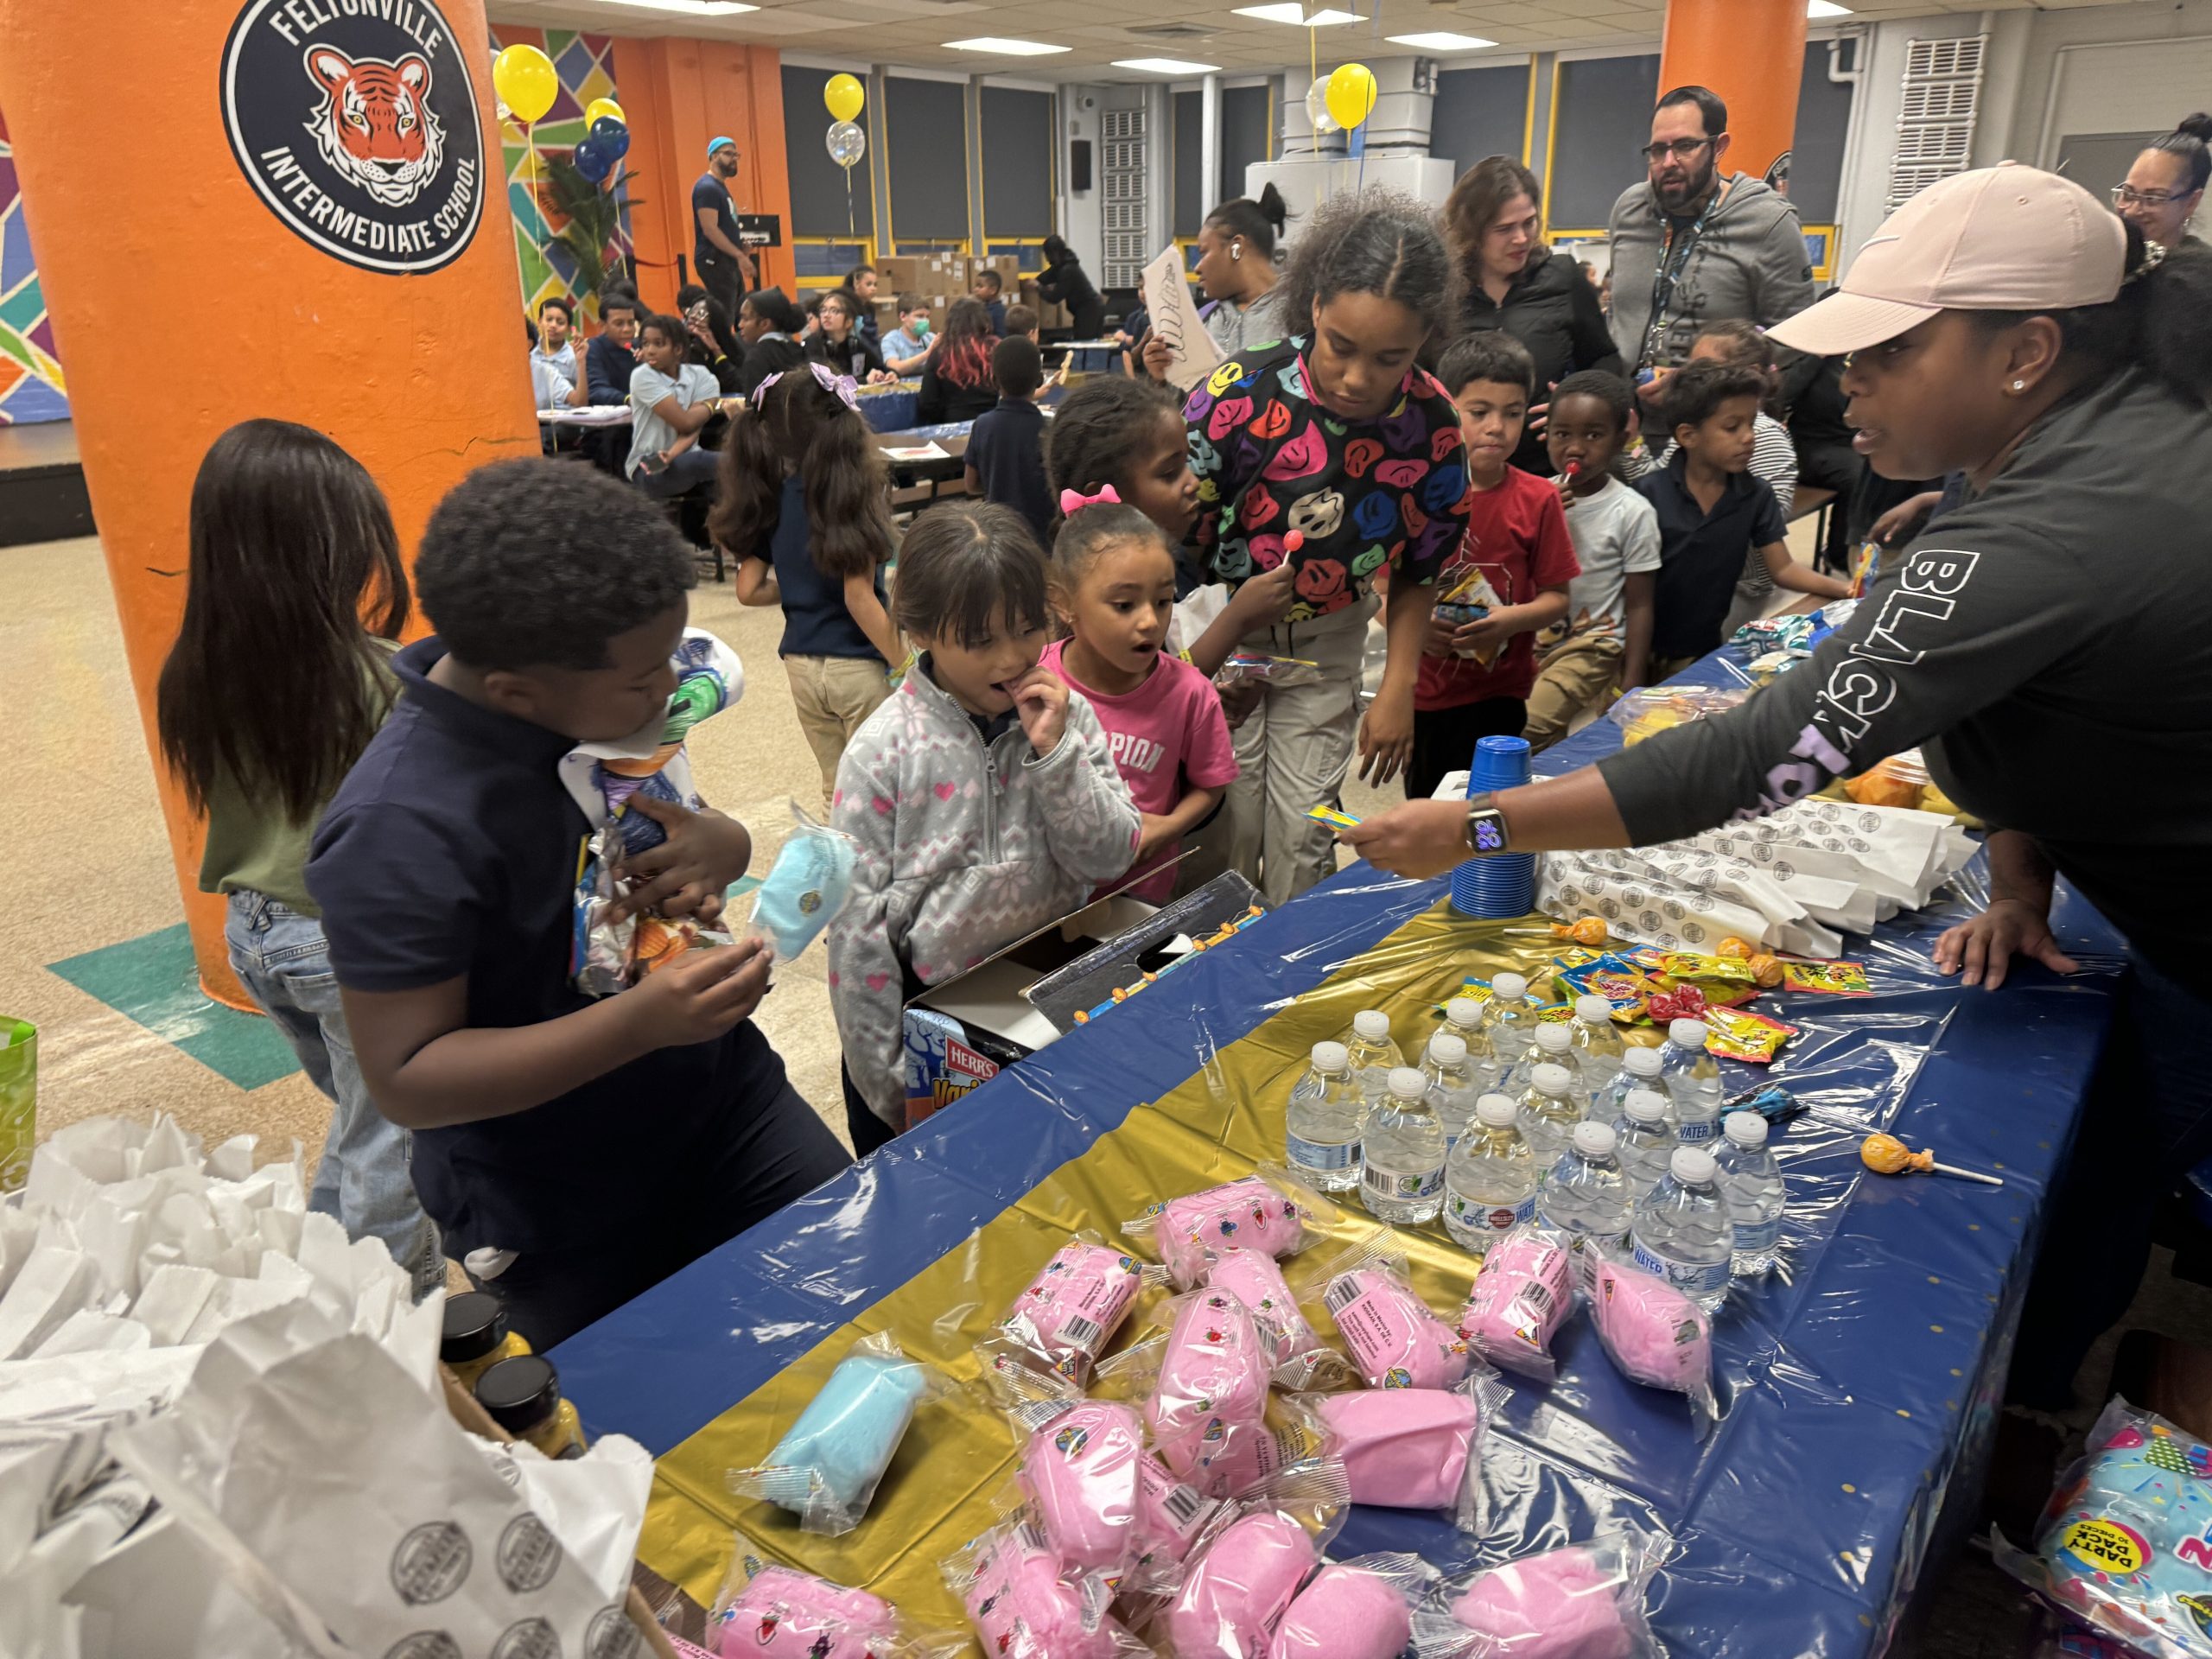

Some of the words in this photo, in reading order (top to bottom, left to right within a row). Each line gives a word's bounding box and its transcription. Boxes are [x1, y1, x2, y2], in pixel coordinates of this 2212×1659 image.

[269, 0, 442, 58] FELTONVILLE
[261, 146, 435, 252] INTERMEDIATE
[434, 158, 475, 240] SCHOOL
[1105, 732, 1166, 773] PION
[951, 1046, 994, 1077] HERR'S
[1634, 1247, 1663, 1274] WATER
